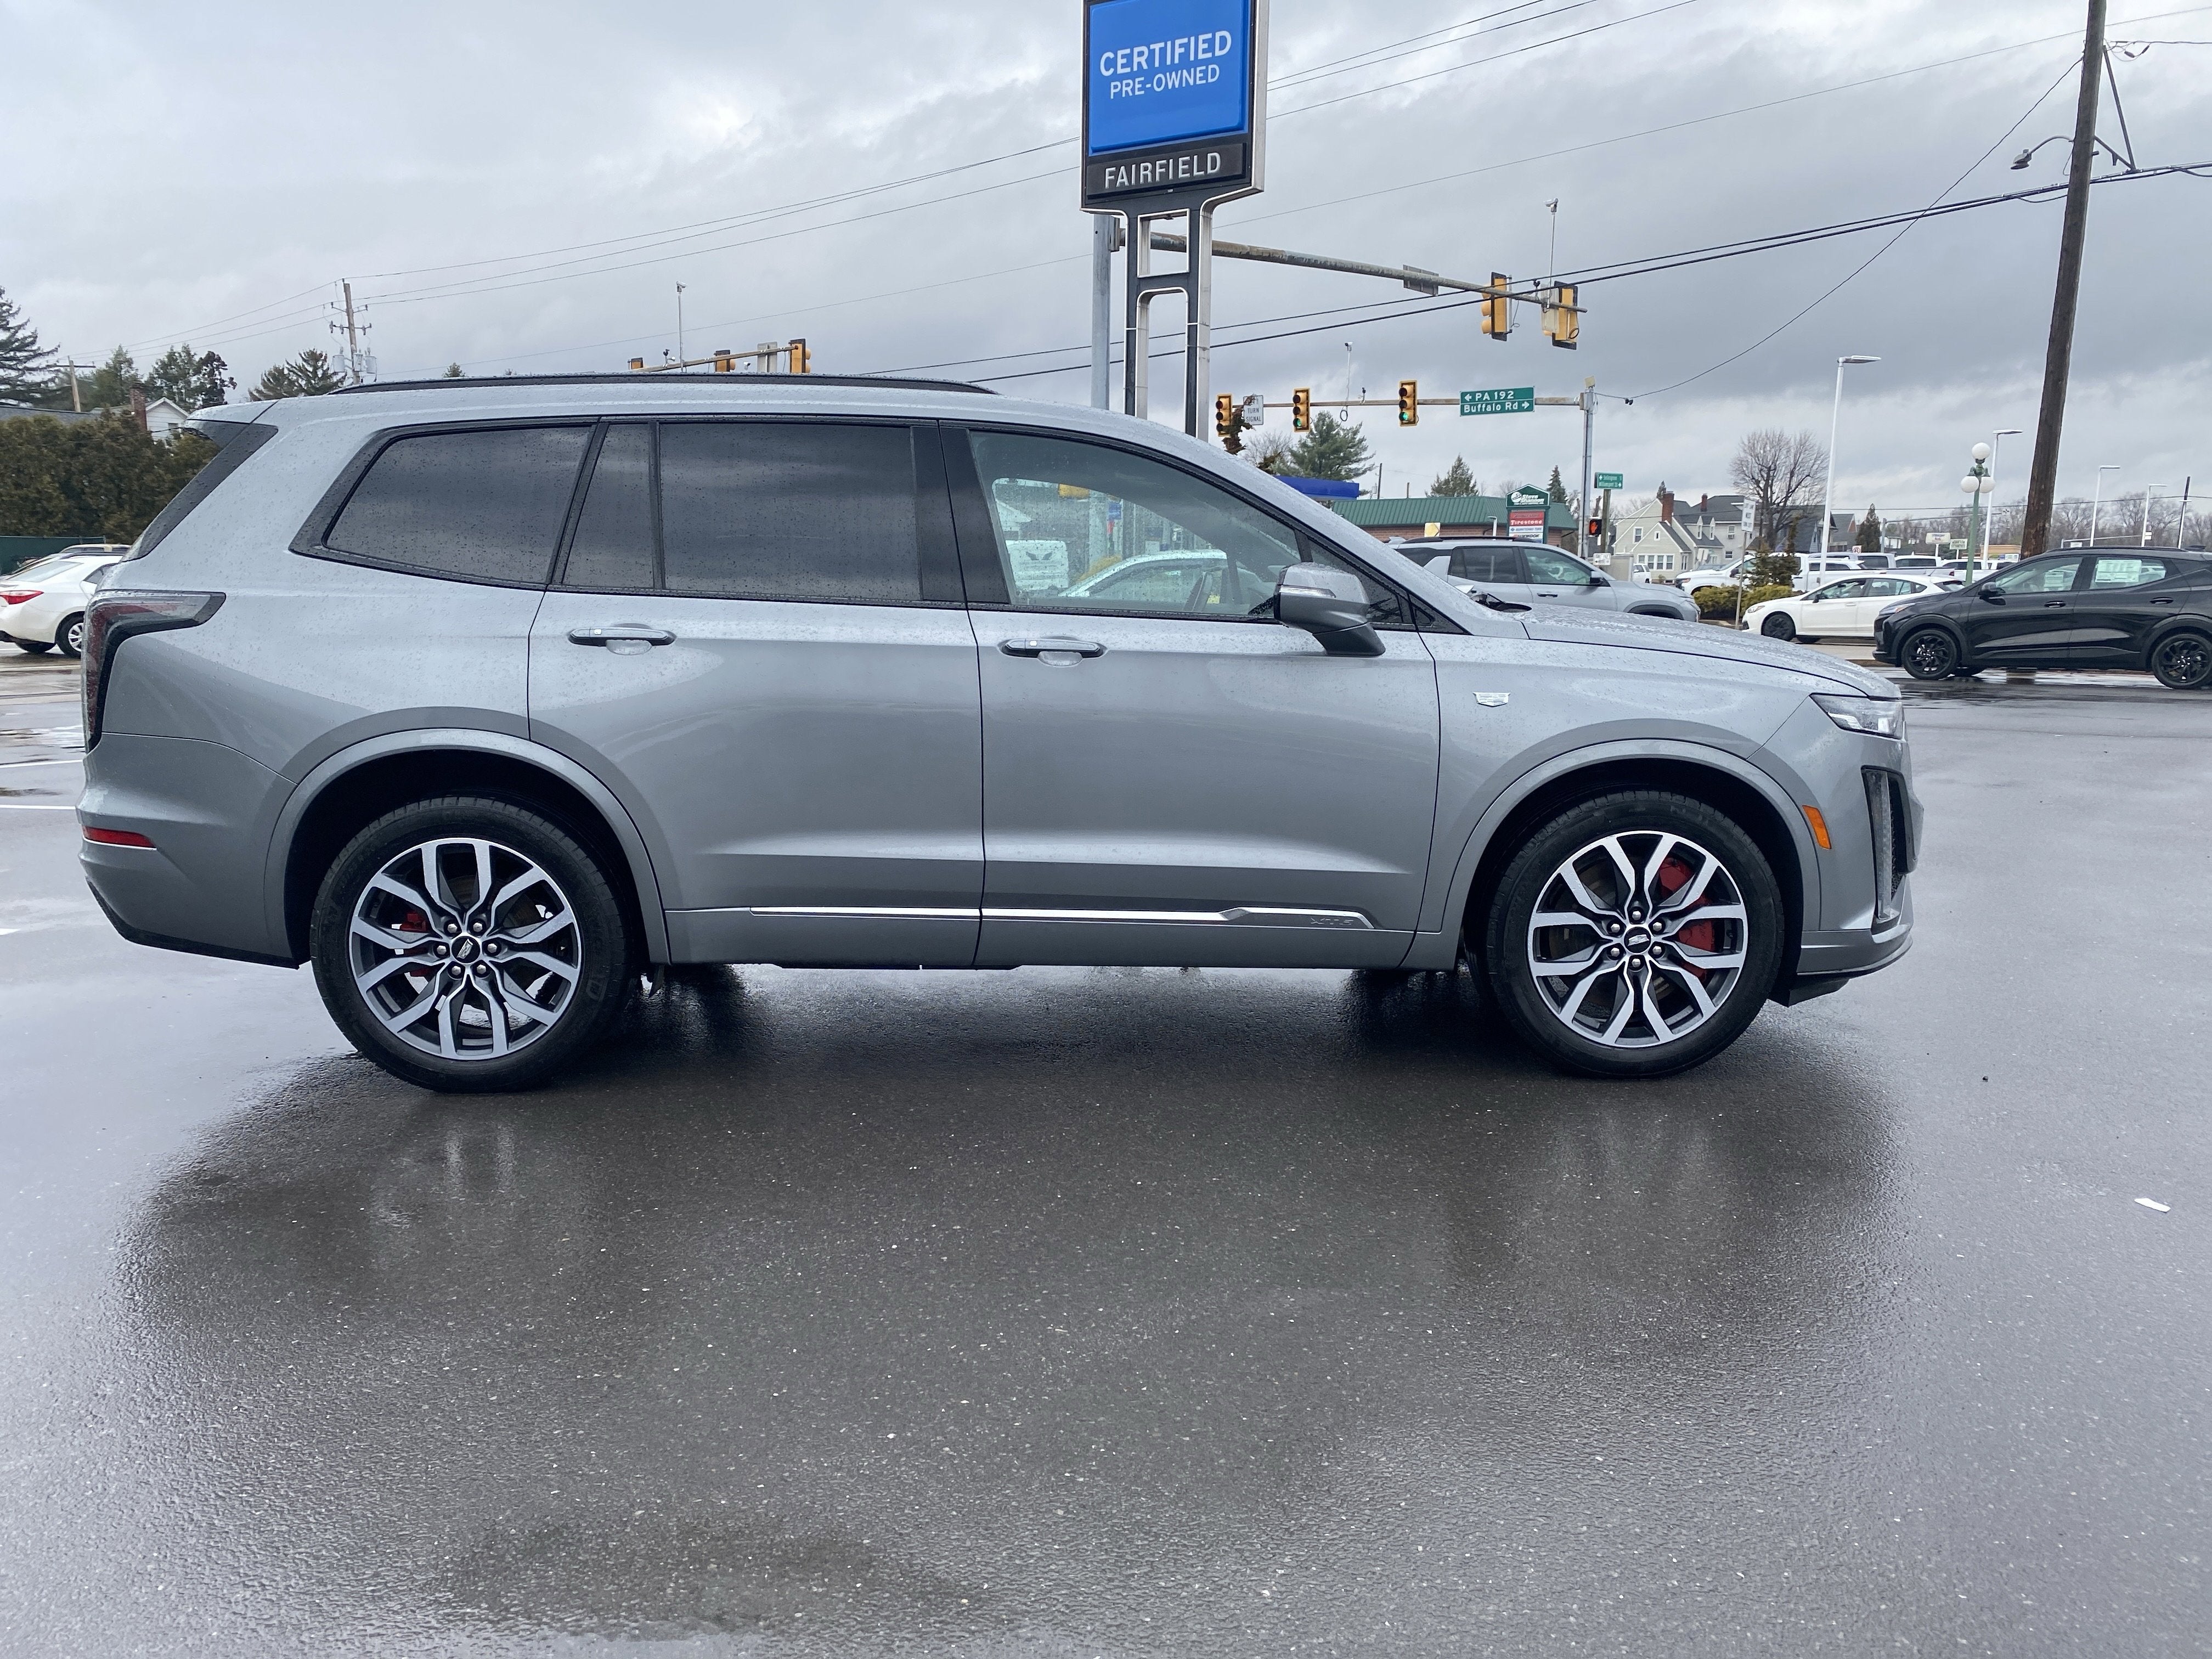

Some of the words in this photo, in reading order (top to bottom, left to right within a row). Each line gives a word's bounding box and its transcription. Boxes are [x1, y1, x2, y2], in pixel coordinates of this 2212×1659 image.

[1099, 30, 1232, 77] CERTIFIED
[1109, 64, 1220, 99] PRE-OWNED
[1104, 151, 1222, 189] FAIRFIELD
[1464, 403, 1502, 413] Buffalo
[1505, 401, 1519, 410] Rd
[1475, 392, 1491, 401] PA
[1494, 390, 1515, 400] 192
